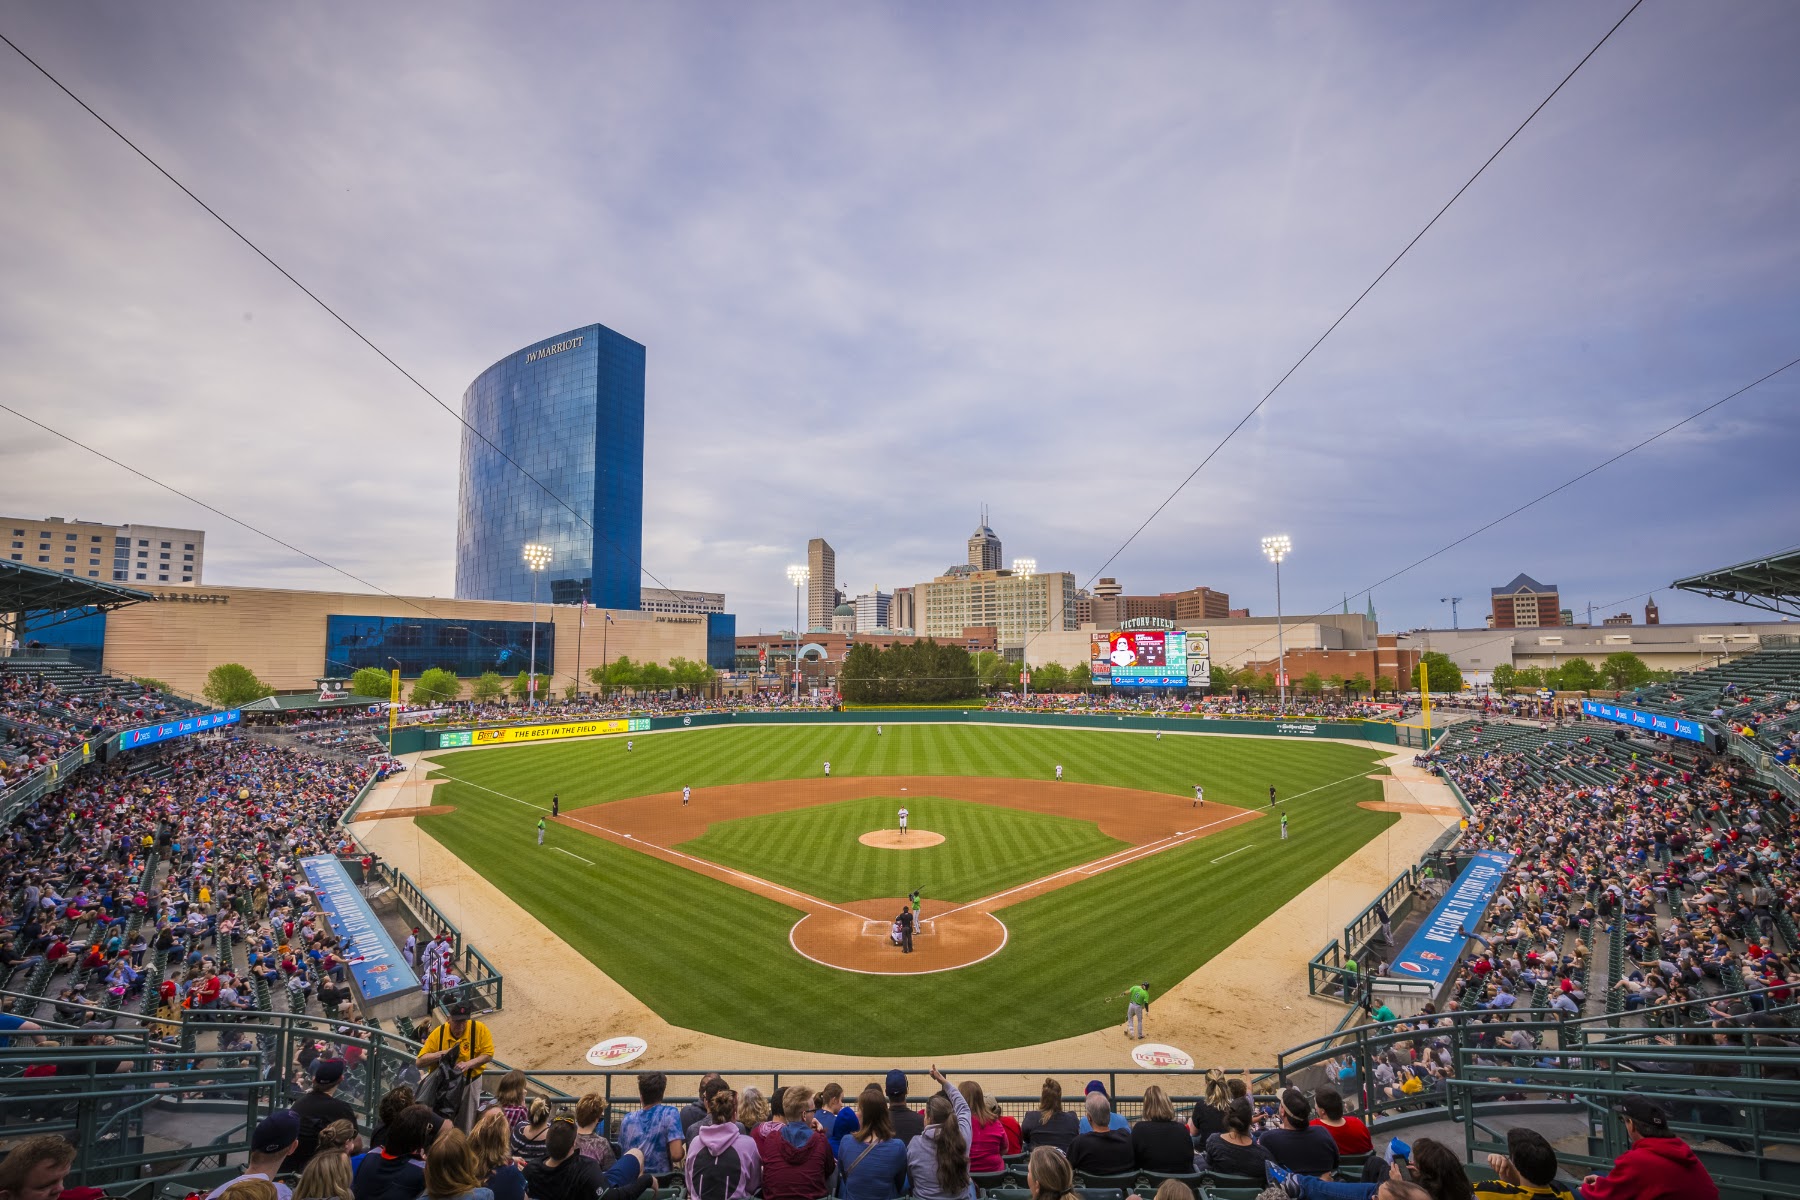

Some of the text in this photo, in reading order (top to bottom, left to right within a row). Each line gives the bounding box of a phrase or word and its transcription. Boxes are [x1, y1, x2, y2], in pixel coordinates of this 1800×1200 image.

[526, 336, 584, 364] JW MARRIOTT
[156, 592, 230, 604] ARRIOTT
[667, 616, 702, 624] MARRIOTT
[1120, 617, 1174, 630] VICTORY FIELD
[1657, 720, 1666, 728] pepsi
[1680, 725, 1692, 734] pepsi
[1454, 878, 1488, 901] VICTORY
[1448, 899, 1474, 909] TO
[330, 892, 370, 932] INDIANAPOLIS
[352, 930, 390, 962] INDIANS
[1424, 907, 1468, 943] WELCOME
[590, 1046, 642, 1058] LOTTERY
[1136, 1054, 1188, 1066] LOTTERY
